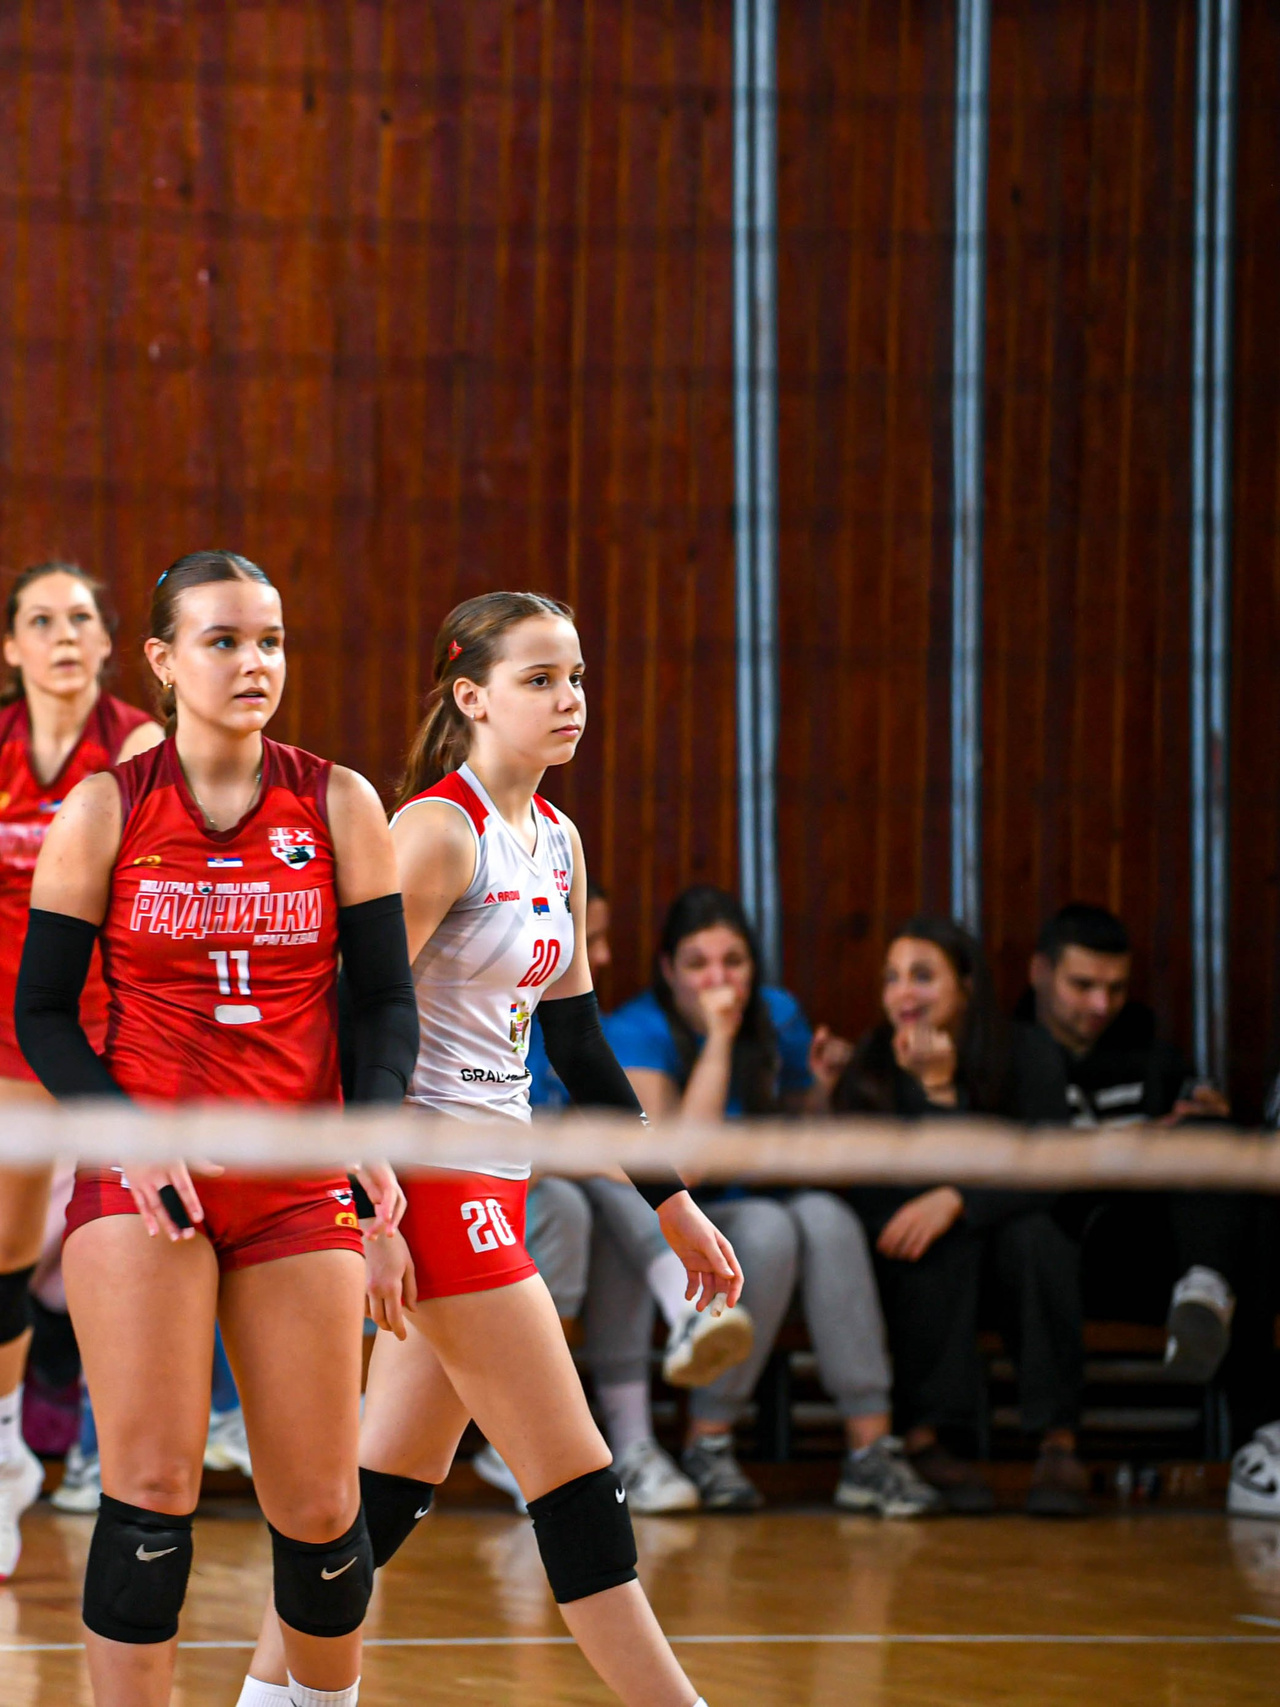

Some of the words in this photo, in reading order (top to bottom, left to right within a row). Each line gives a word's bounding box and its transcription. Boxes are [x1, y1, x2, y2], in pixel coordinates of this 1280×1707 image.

[130, 888, 322, 939] РАДНИЧКИ
[208, 950, 251, 996] 11
[516, 939, 561, 988] 20
[460, 1198, 517, 1254] 20
